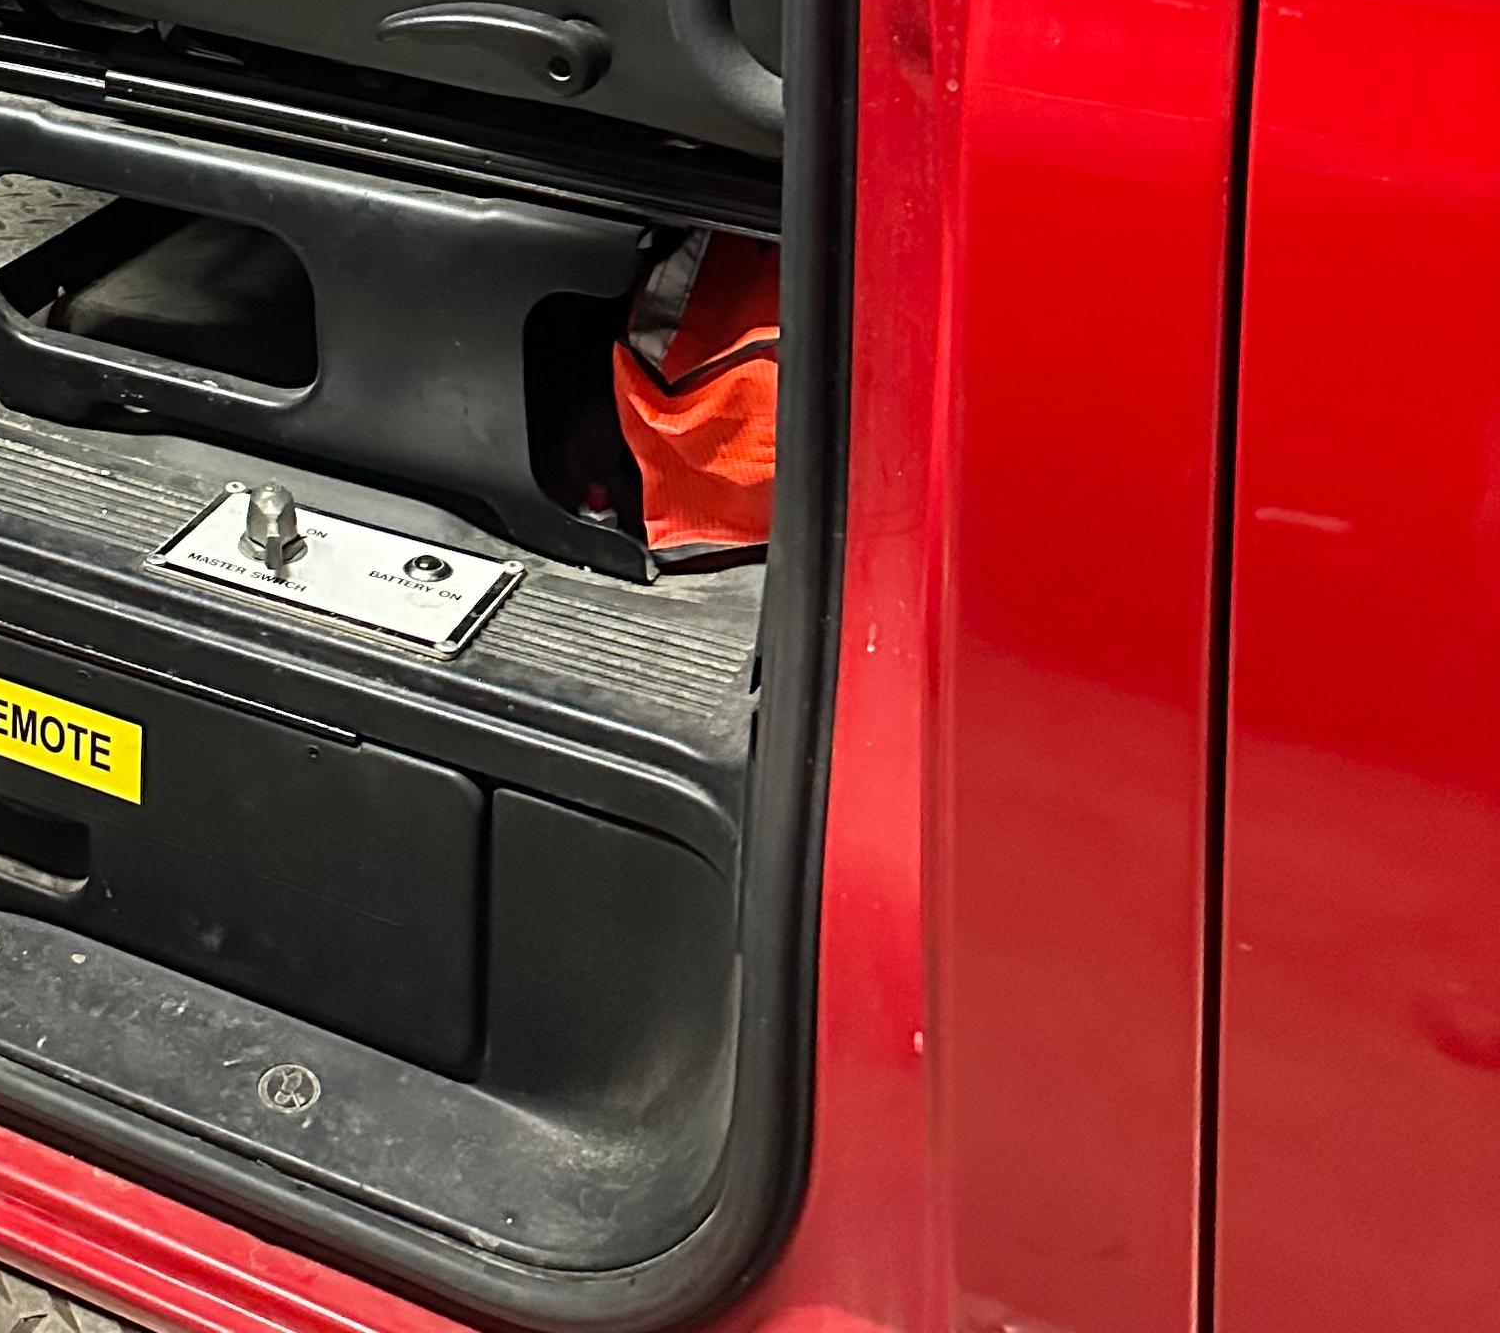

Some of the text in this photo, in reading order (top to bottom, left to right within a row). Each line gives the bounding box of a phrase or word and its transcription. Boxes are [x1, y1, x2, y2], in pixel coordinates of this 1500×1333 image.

[306, 528, 329, 539] ON
[188, 552, 308, 593] MASTER SWITCH
[368, 570, 463, 602] BATTERY ON
